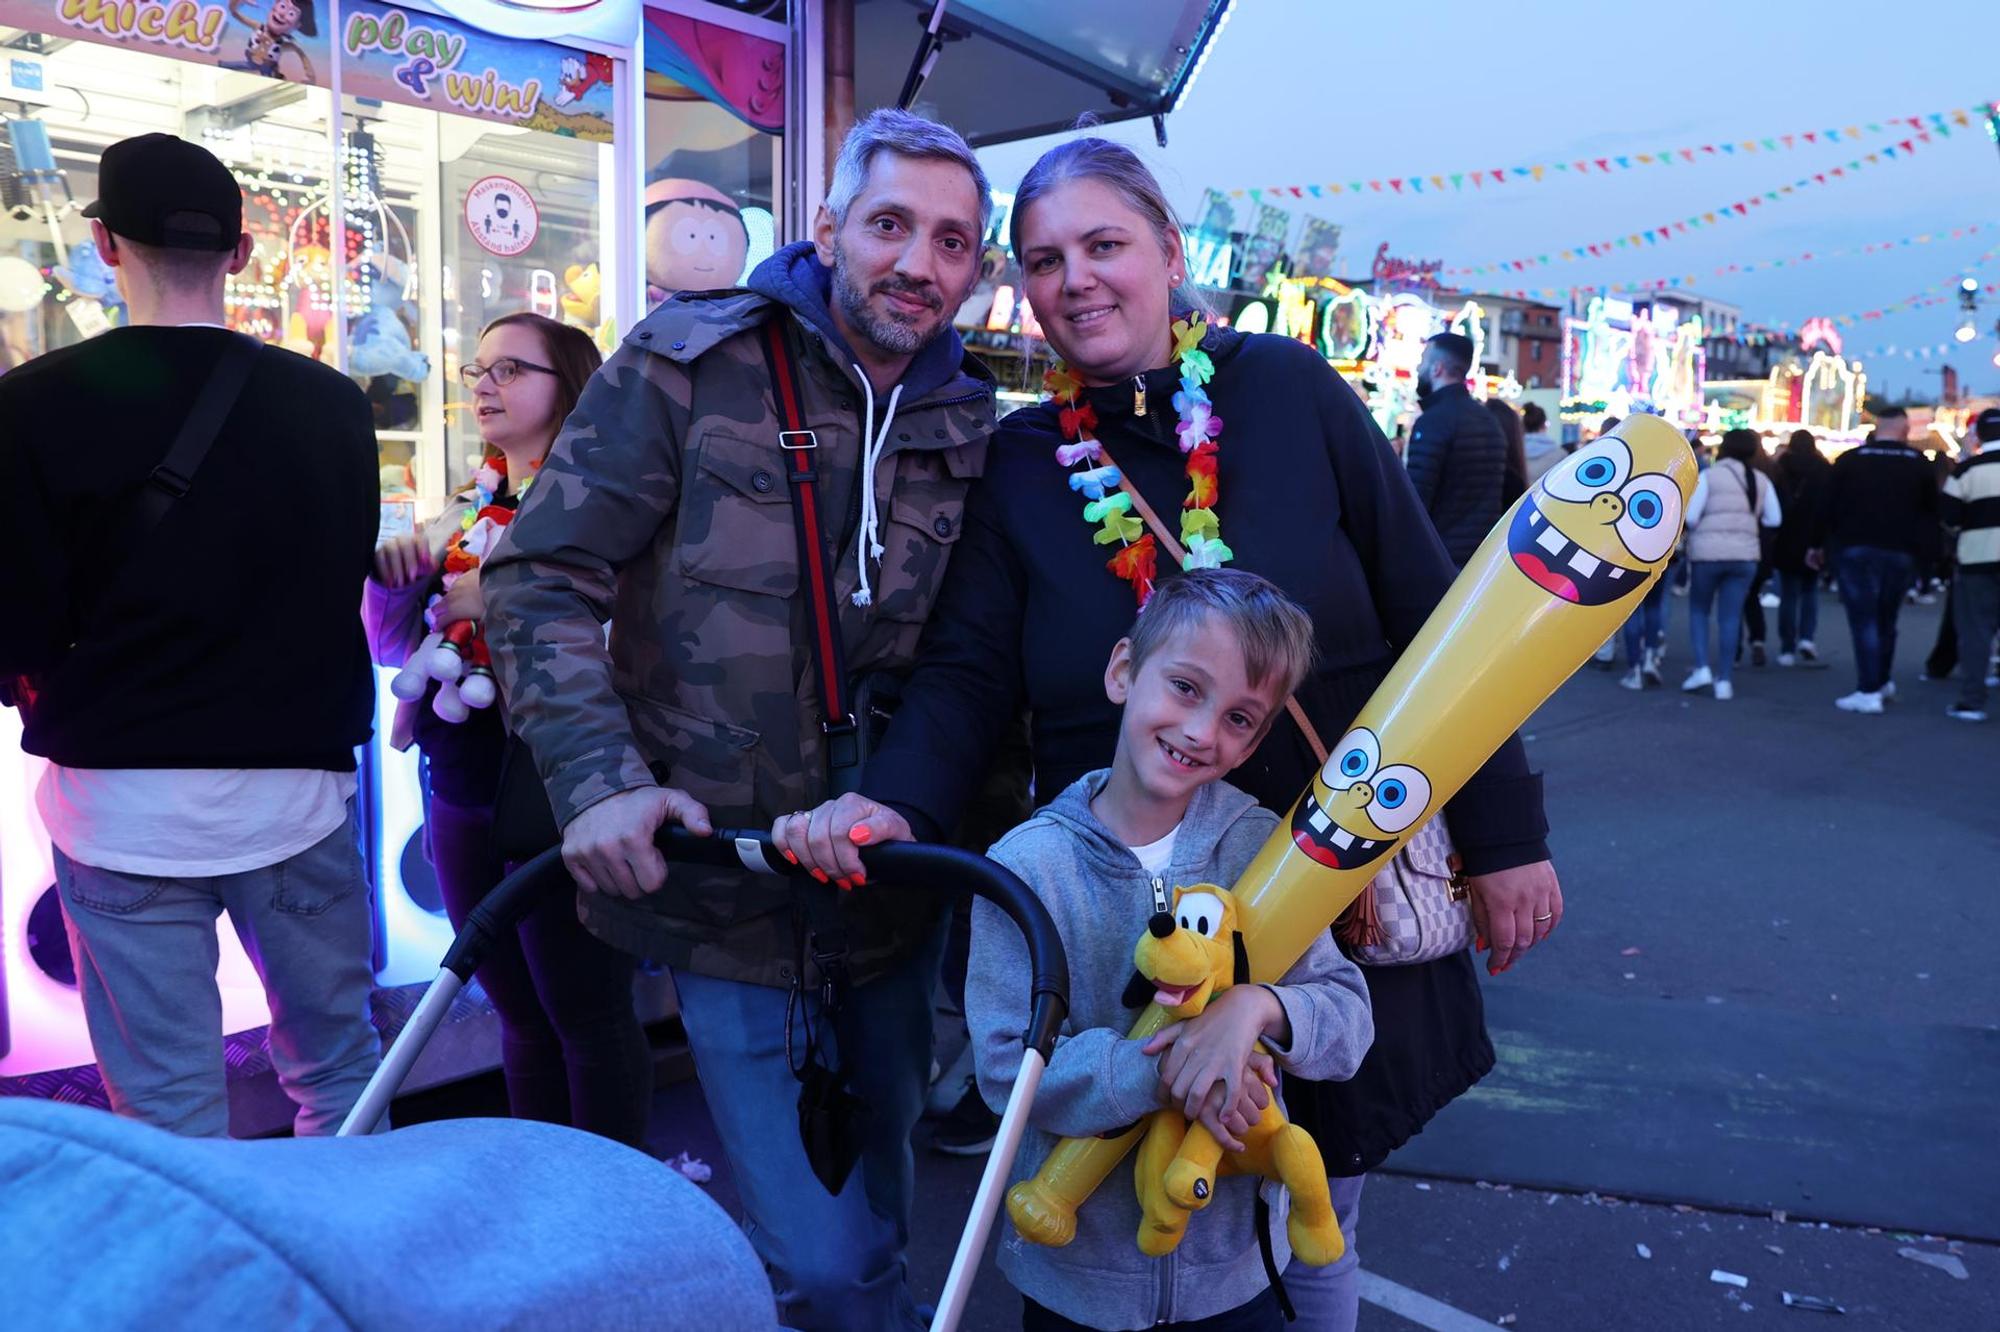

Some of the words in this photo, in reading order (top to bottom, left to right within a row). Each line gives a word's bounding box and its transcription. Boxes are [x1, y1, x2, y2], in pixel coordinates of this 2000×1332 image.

[61, 0, 224, 47] mich!
[347, 11, 463, 69] play
[396, 57, 435, 94] &
[445, 70, 539, 114] win!
[471, 220, 502, 252] Abstand
